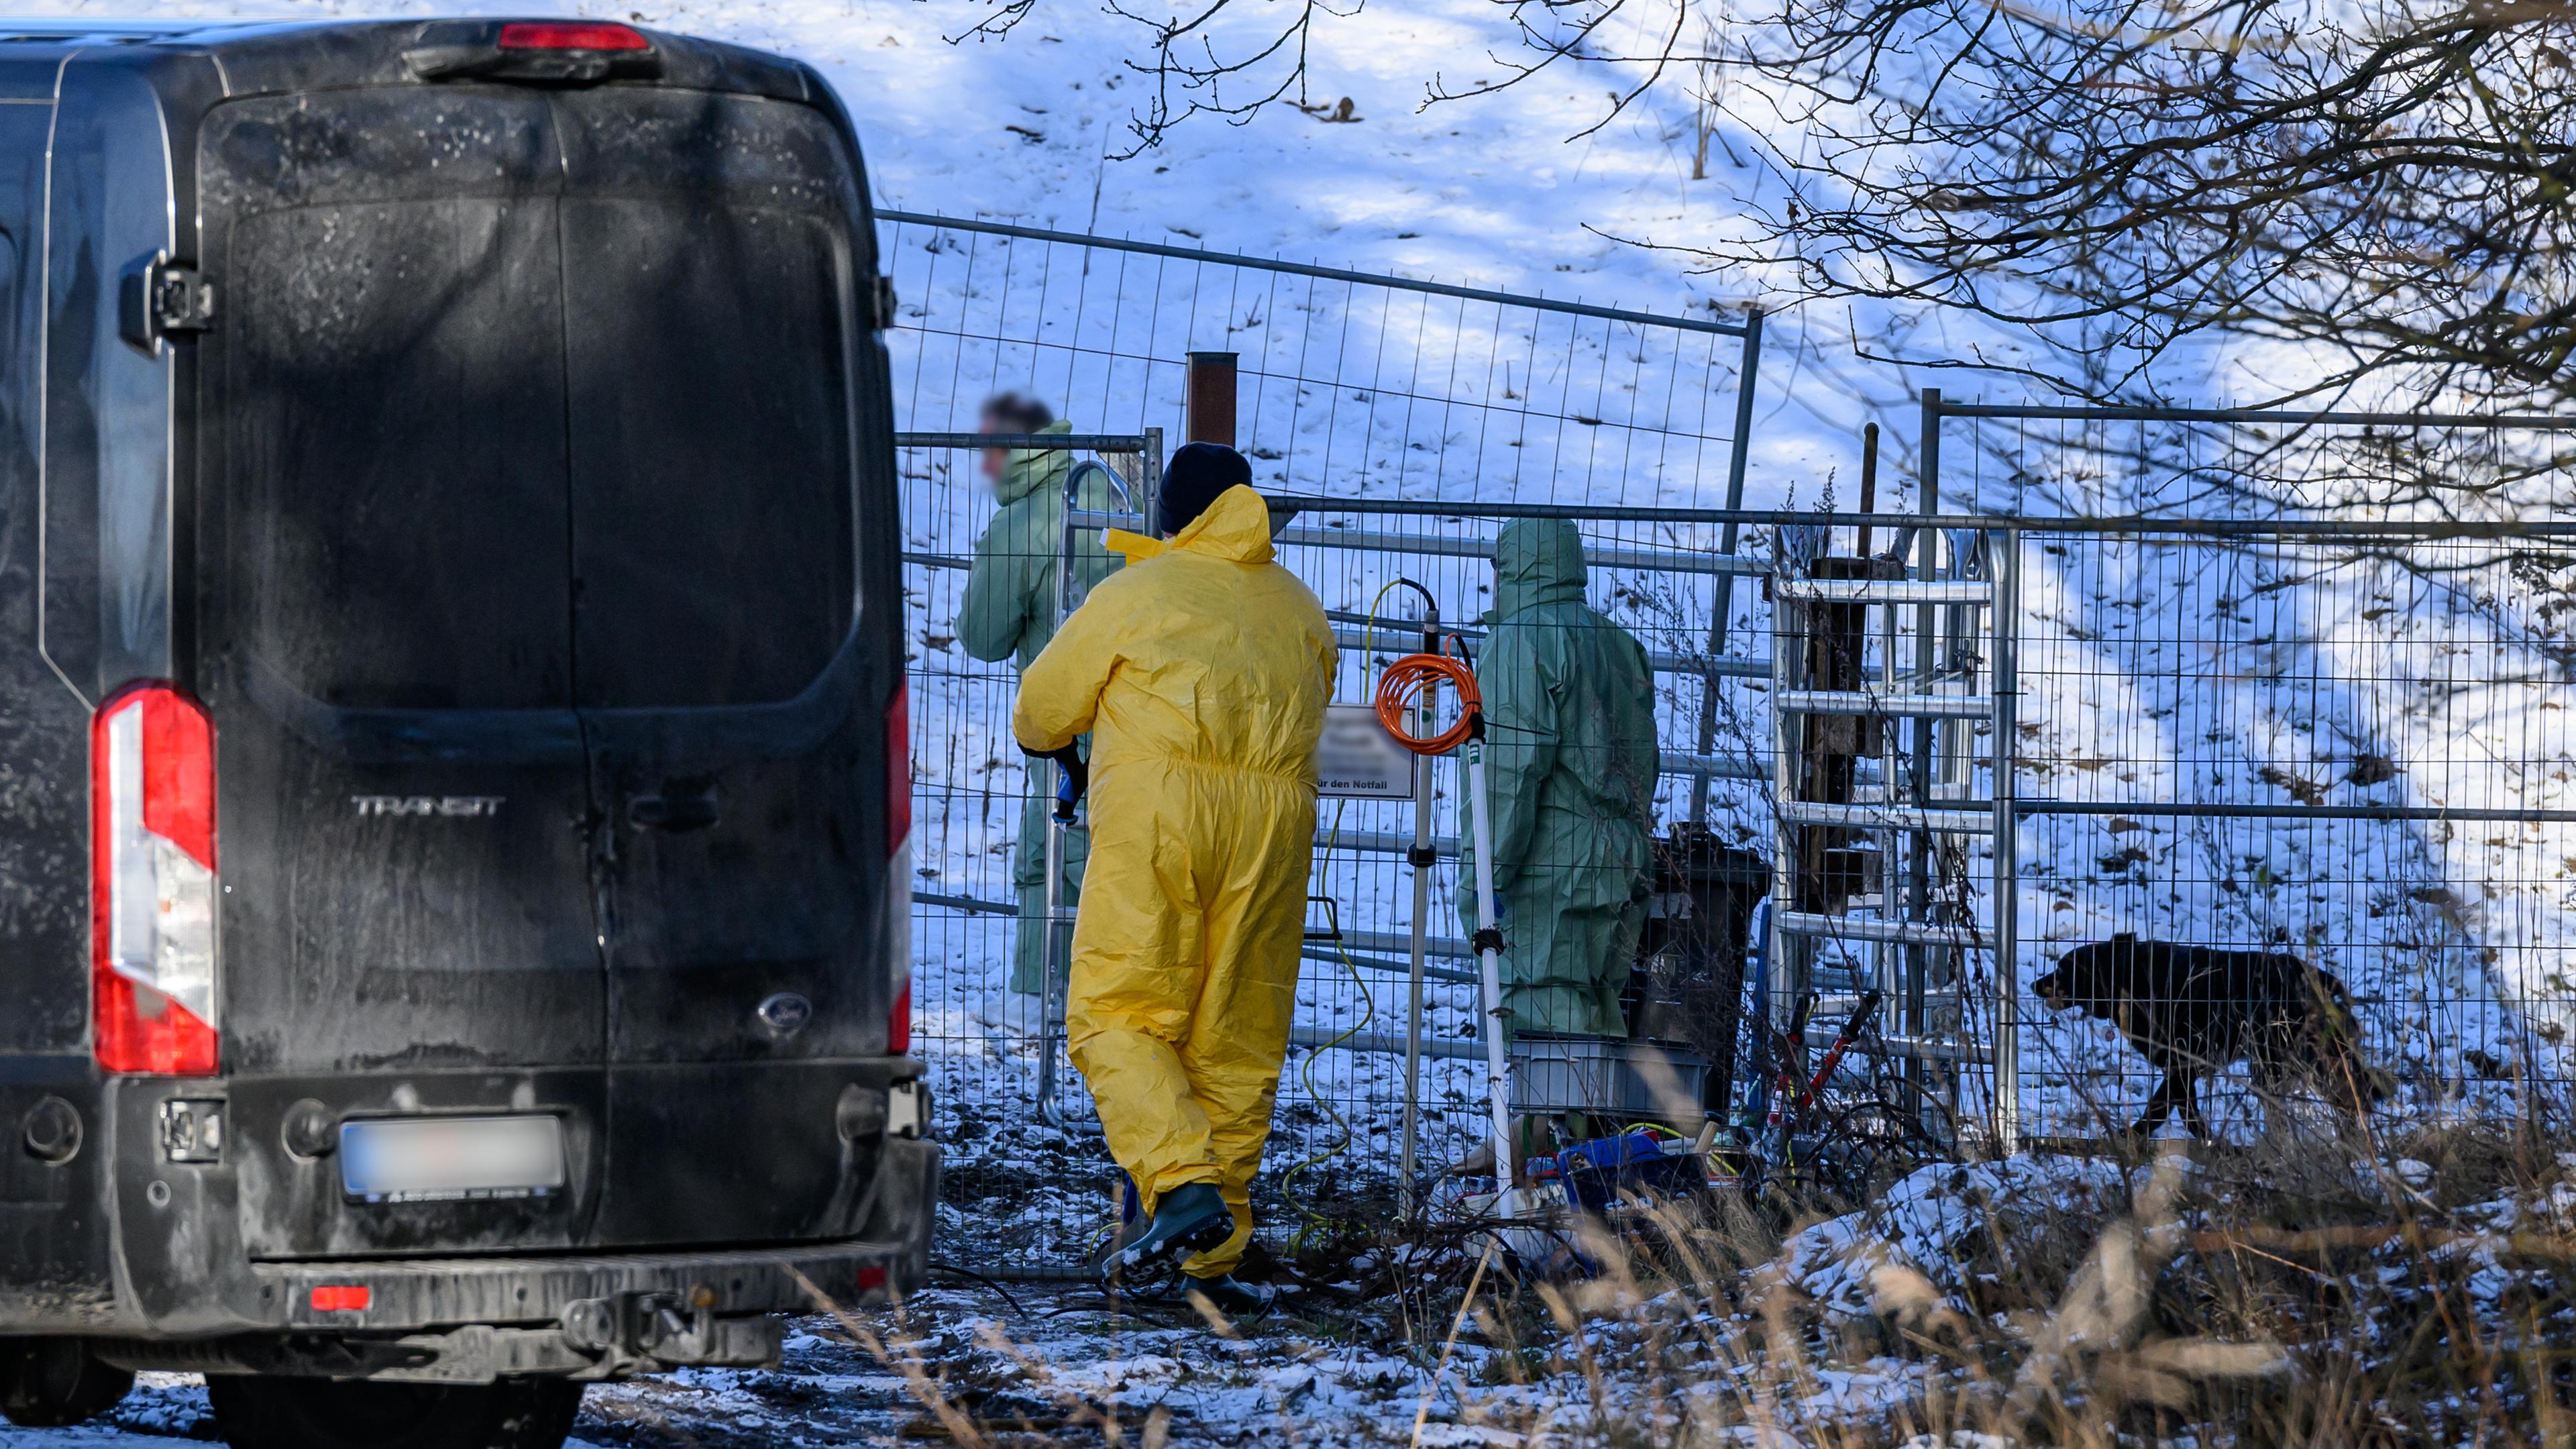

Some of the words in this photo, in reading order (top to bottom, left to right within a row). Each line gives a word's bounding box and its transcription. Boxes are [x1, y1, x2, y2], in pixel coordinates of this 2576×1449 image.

[1318, 779, 1328, 788] ür
[1330, 780, 1350, 788] den
[1352, 780, 1387, 790] Notfall
[350, 795, 506, 816] TRANSIT
